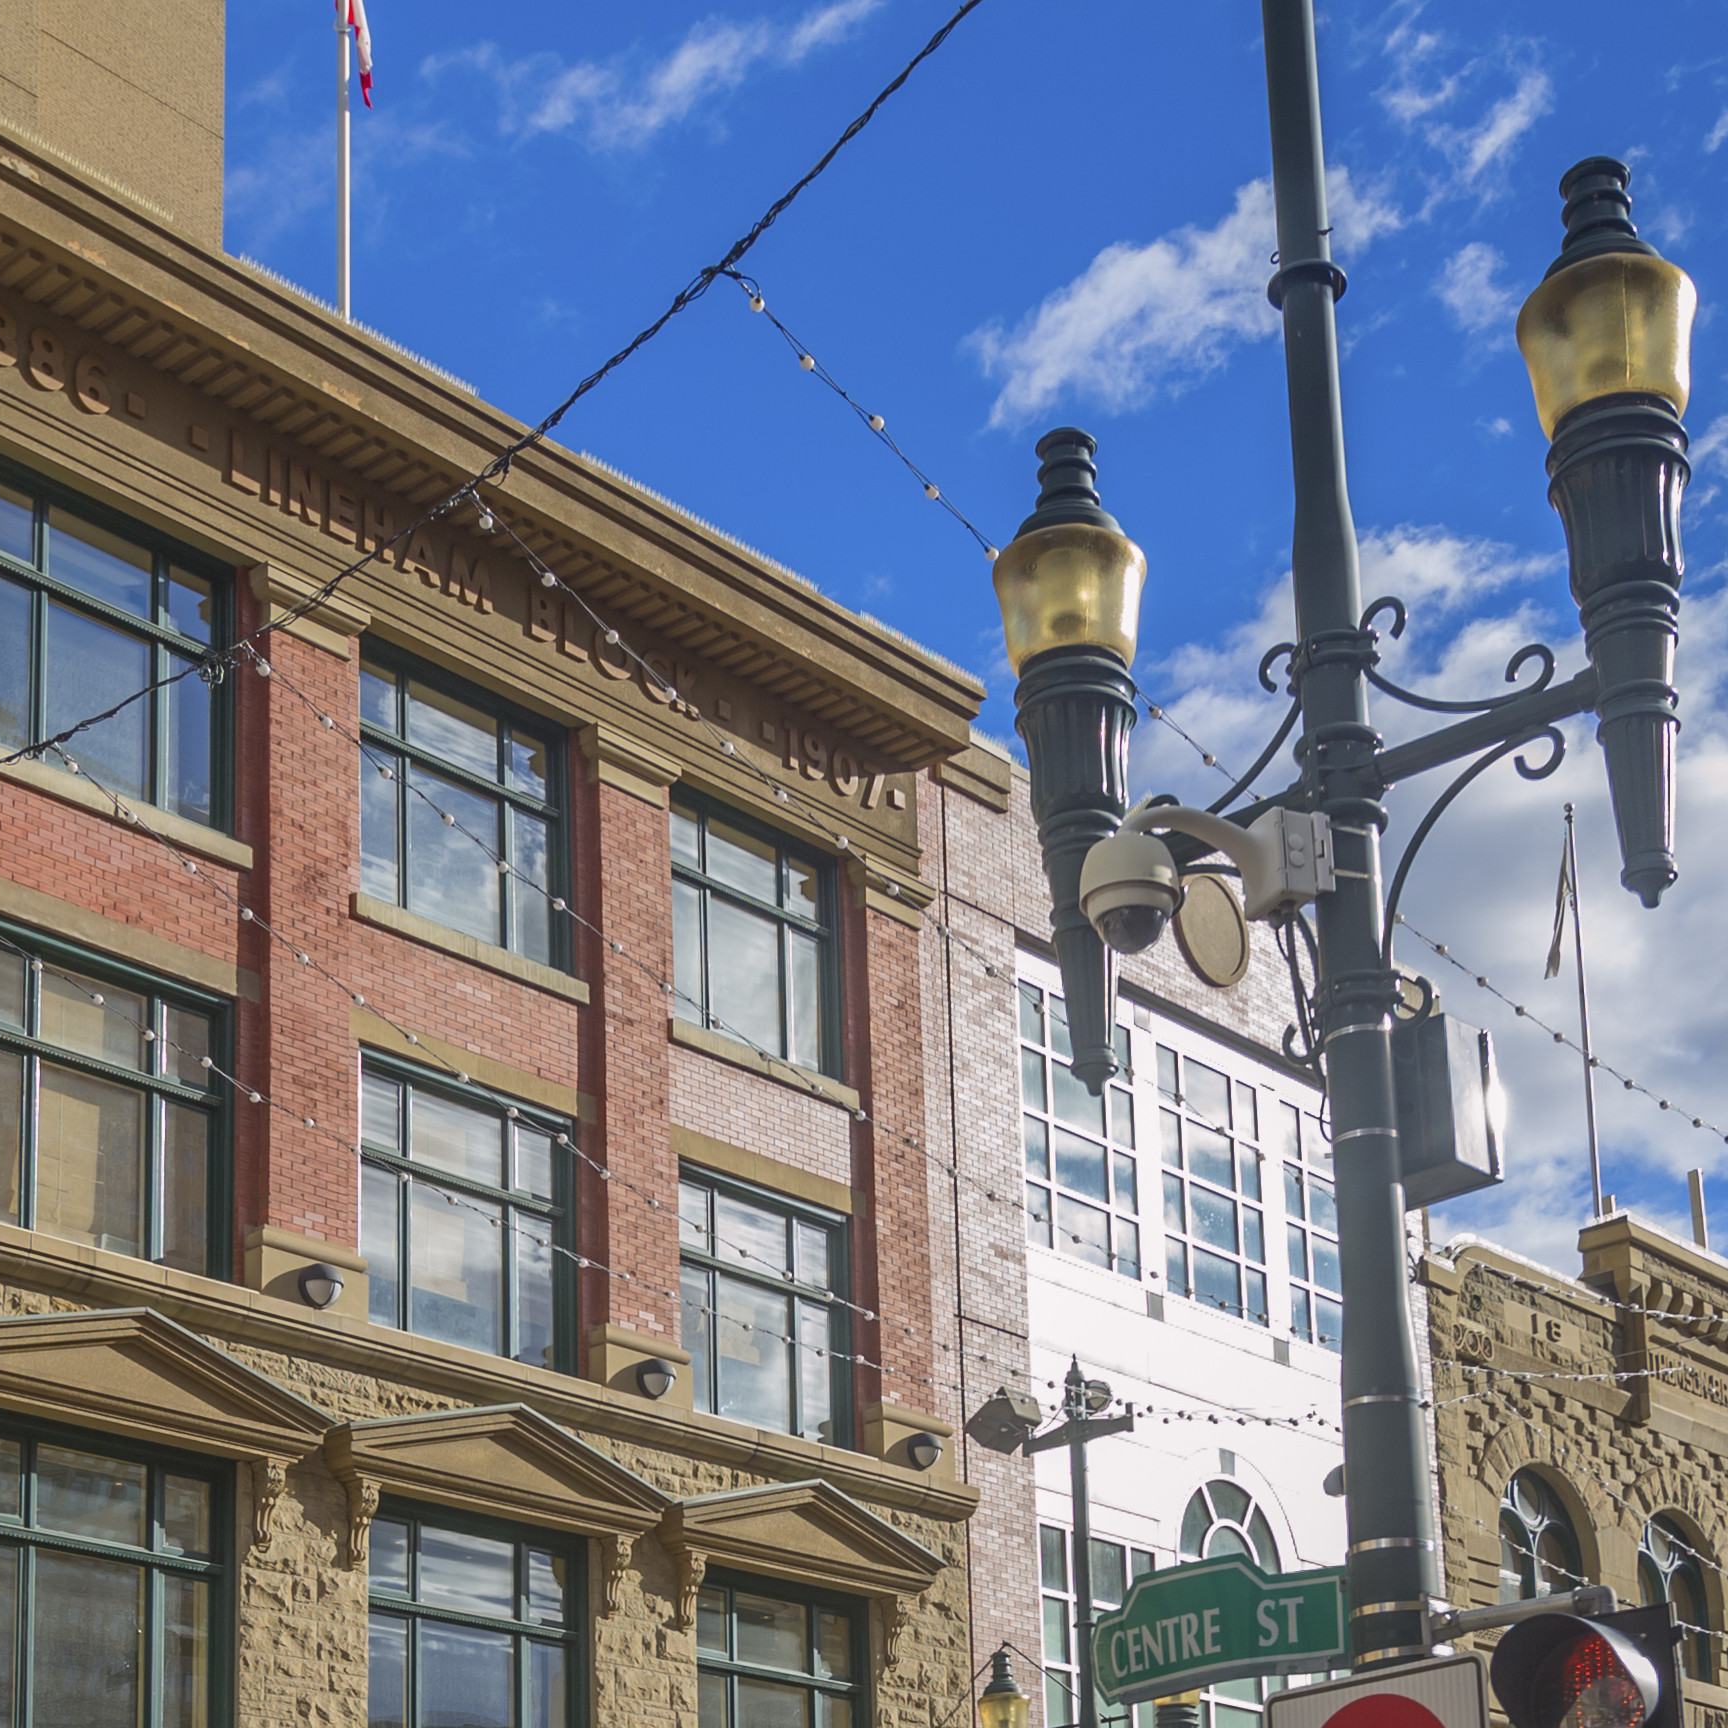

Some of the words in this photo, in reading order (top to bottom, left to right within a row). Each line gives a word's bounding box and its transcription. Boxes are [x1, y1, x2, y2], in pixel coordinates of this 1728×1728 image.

[224, 428, 494, 614] LINEHAM
[527, 584, 700, 720] BLOCK
[783, 718, 885, 809] 1907
[1530, 1313, 1561, 1343] 18
[1110, 1607, 1221, 1679] CENTRE
[1256, 1596, 1304, 1648] ST
